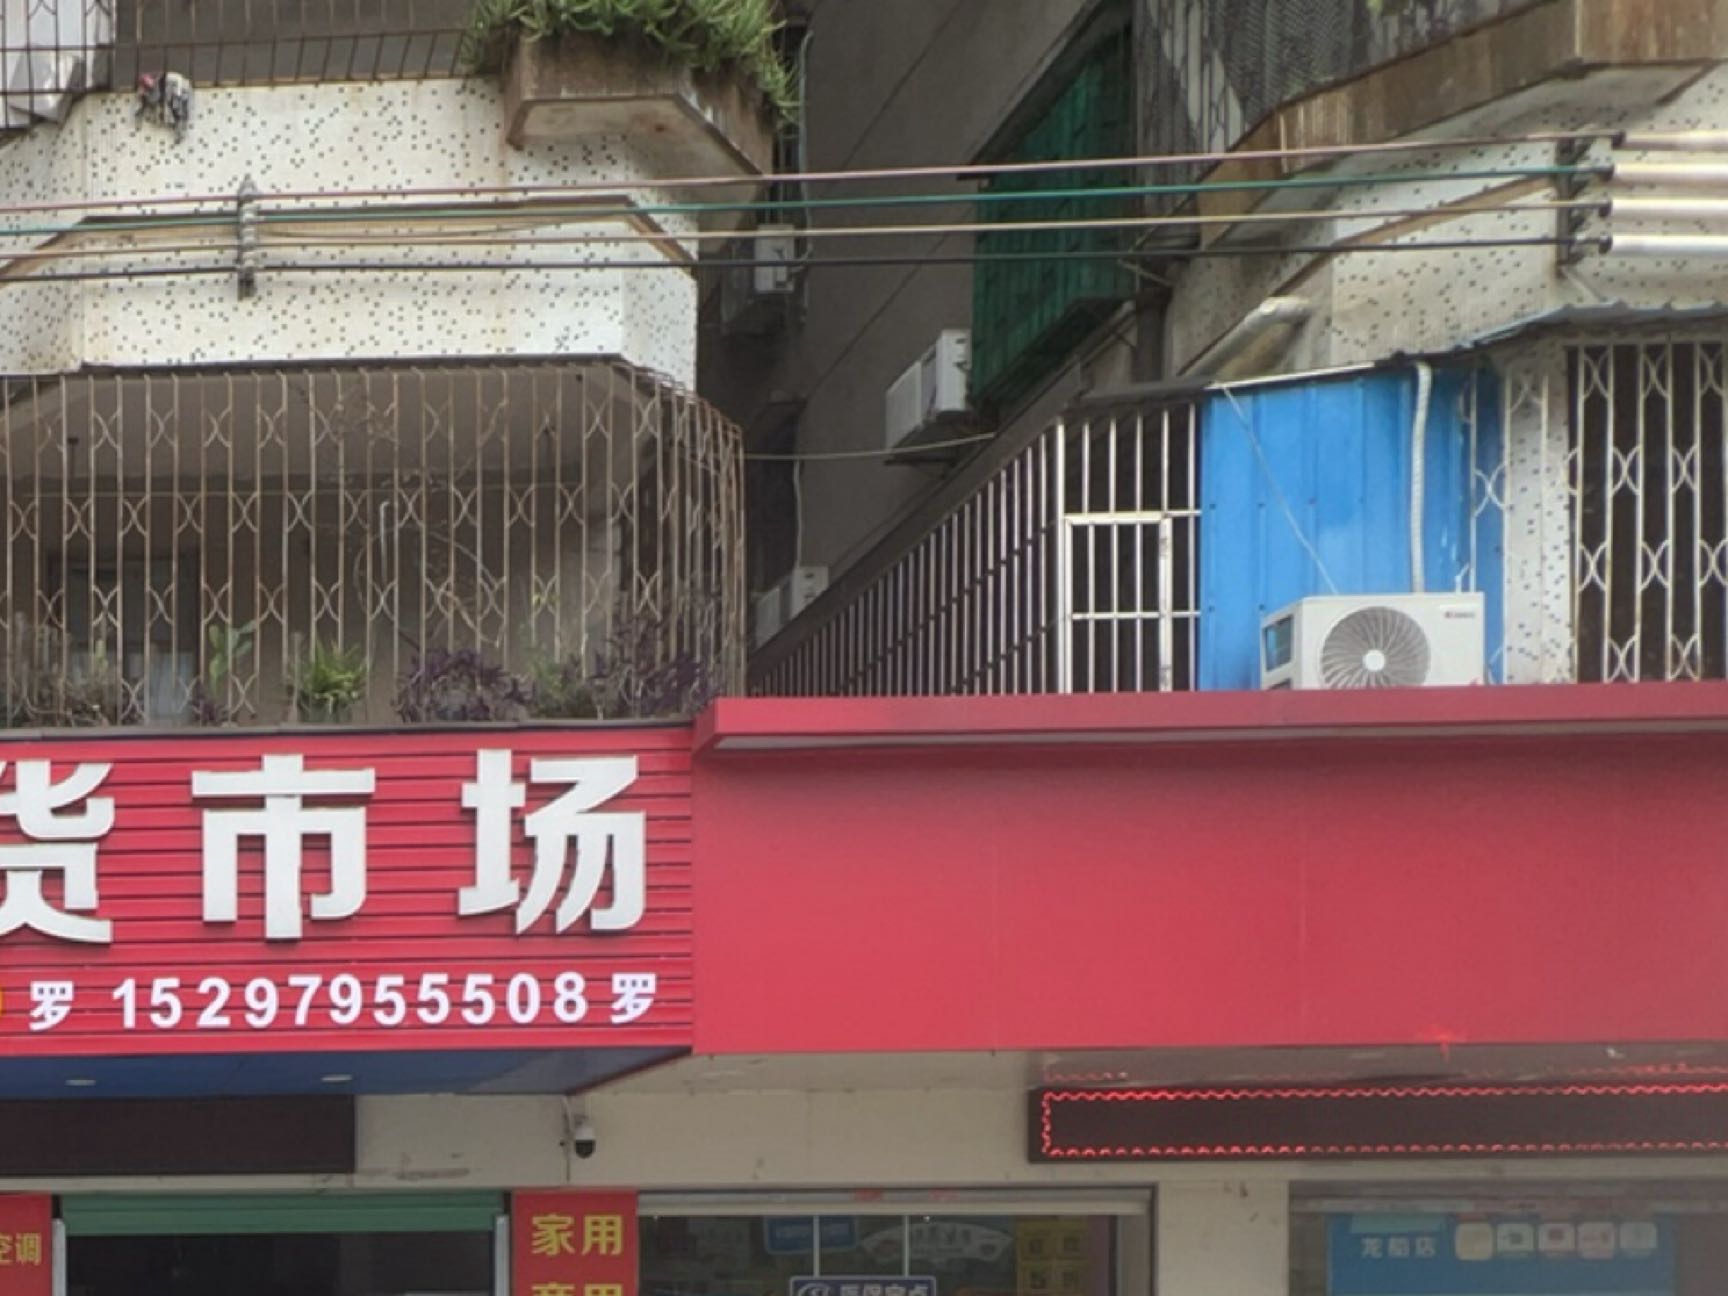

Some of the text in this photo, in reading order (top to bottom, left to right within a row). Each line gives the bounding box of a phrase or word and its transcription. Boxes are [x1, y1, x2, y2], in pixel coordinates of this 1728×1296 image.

[28, 979, 75, 1032] 罗
[111, 970, 590, 1031] 15297955508
[609, 972, 657, 1026] 罗
[531, 1213, 624, 1257] 家用
